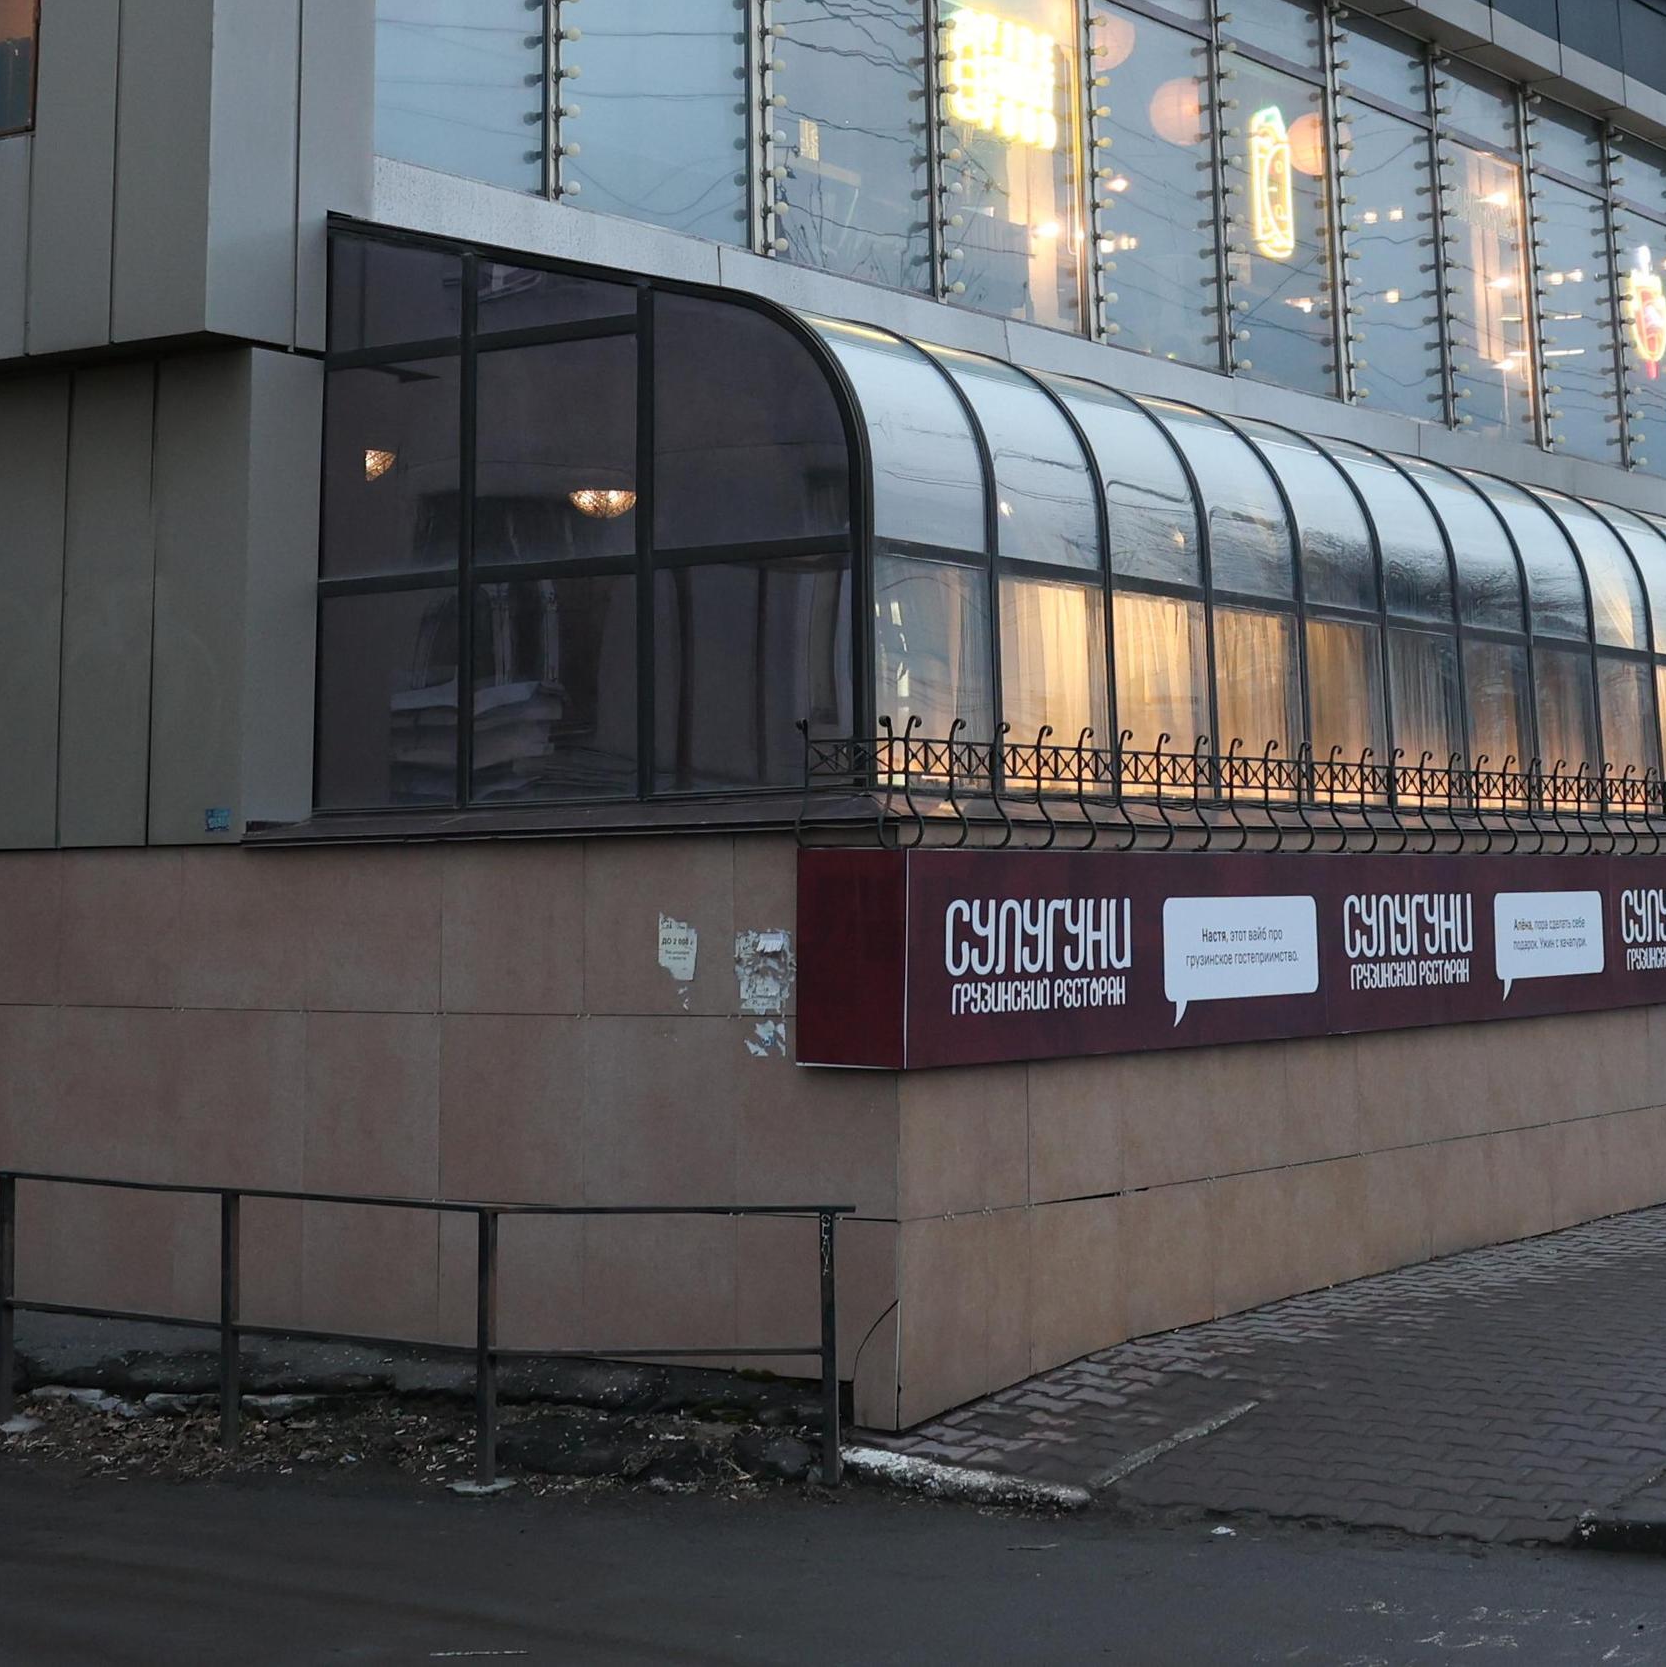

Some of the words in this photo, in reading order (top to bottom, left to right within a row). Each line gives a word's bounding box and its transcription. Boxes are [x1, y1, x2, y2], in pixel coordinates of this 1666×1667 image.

[945, 897, 1132, 977] СУЛУГУНИ
[1202, 927, 1229, 943] Настя,
[1230, 929, 1247, 942] этот
[1343, 892, 1473, 959] СУЛУГУНИ
[1186, 953, 1233, 970] грузинское
[1350, 960, 1417, 990] ГРУЗИНСКИЙ
[1419, 957, 1470, 986] РЕСТОРАН
[951, 978, 1050, 1015] ГРУЗИНСКИЙ
[1054, 976, 1126, 1009] РЕСТОРАН
